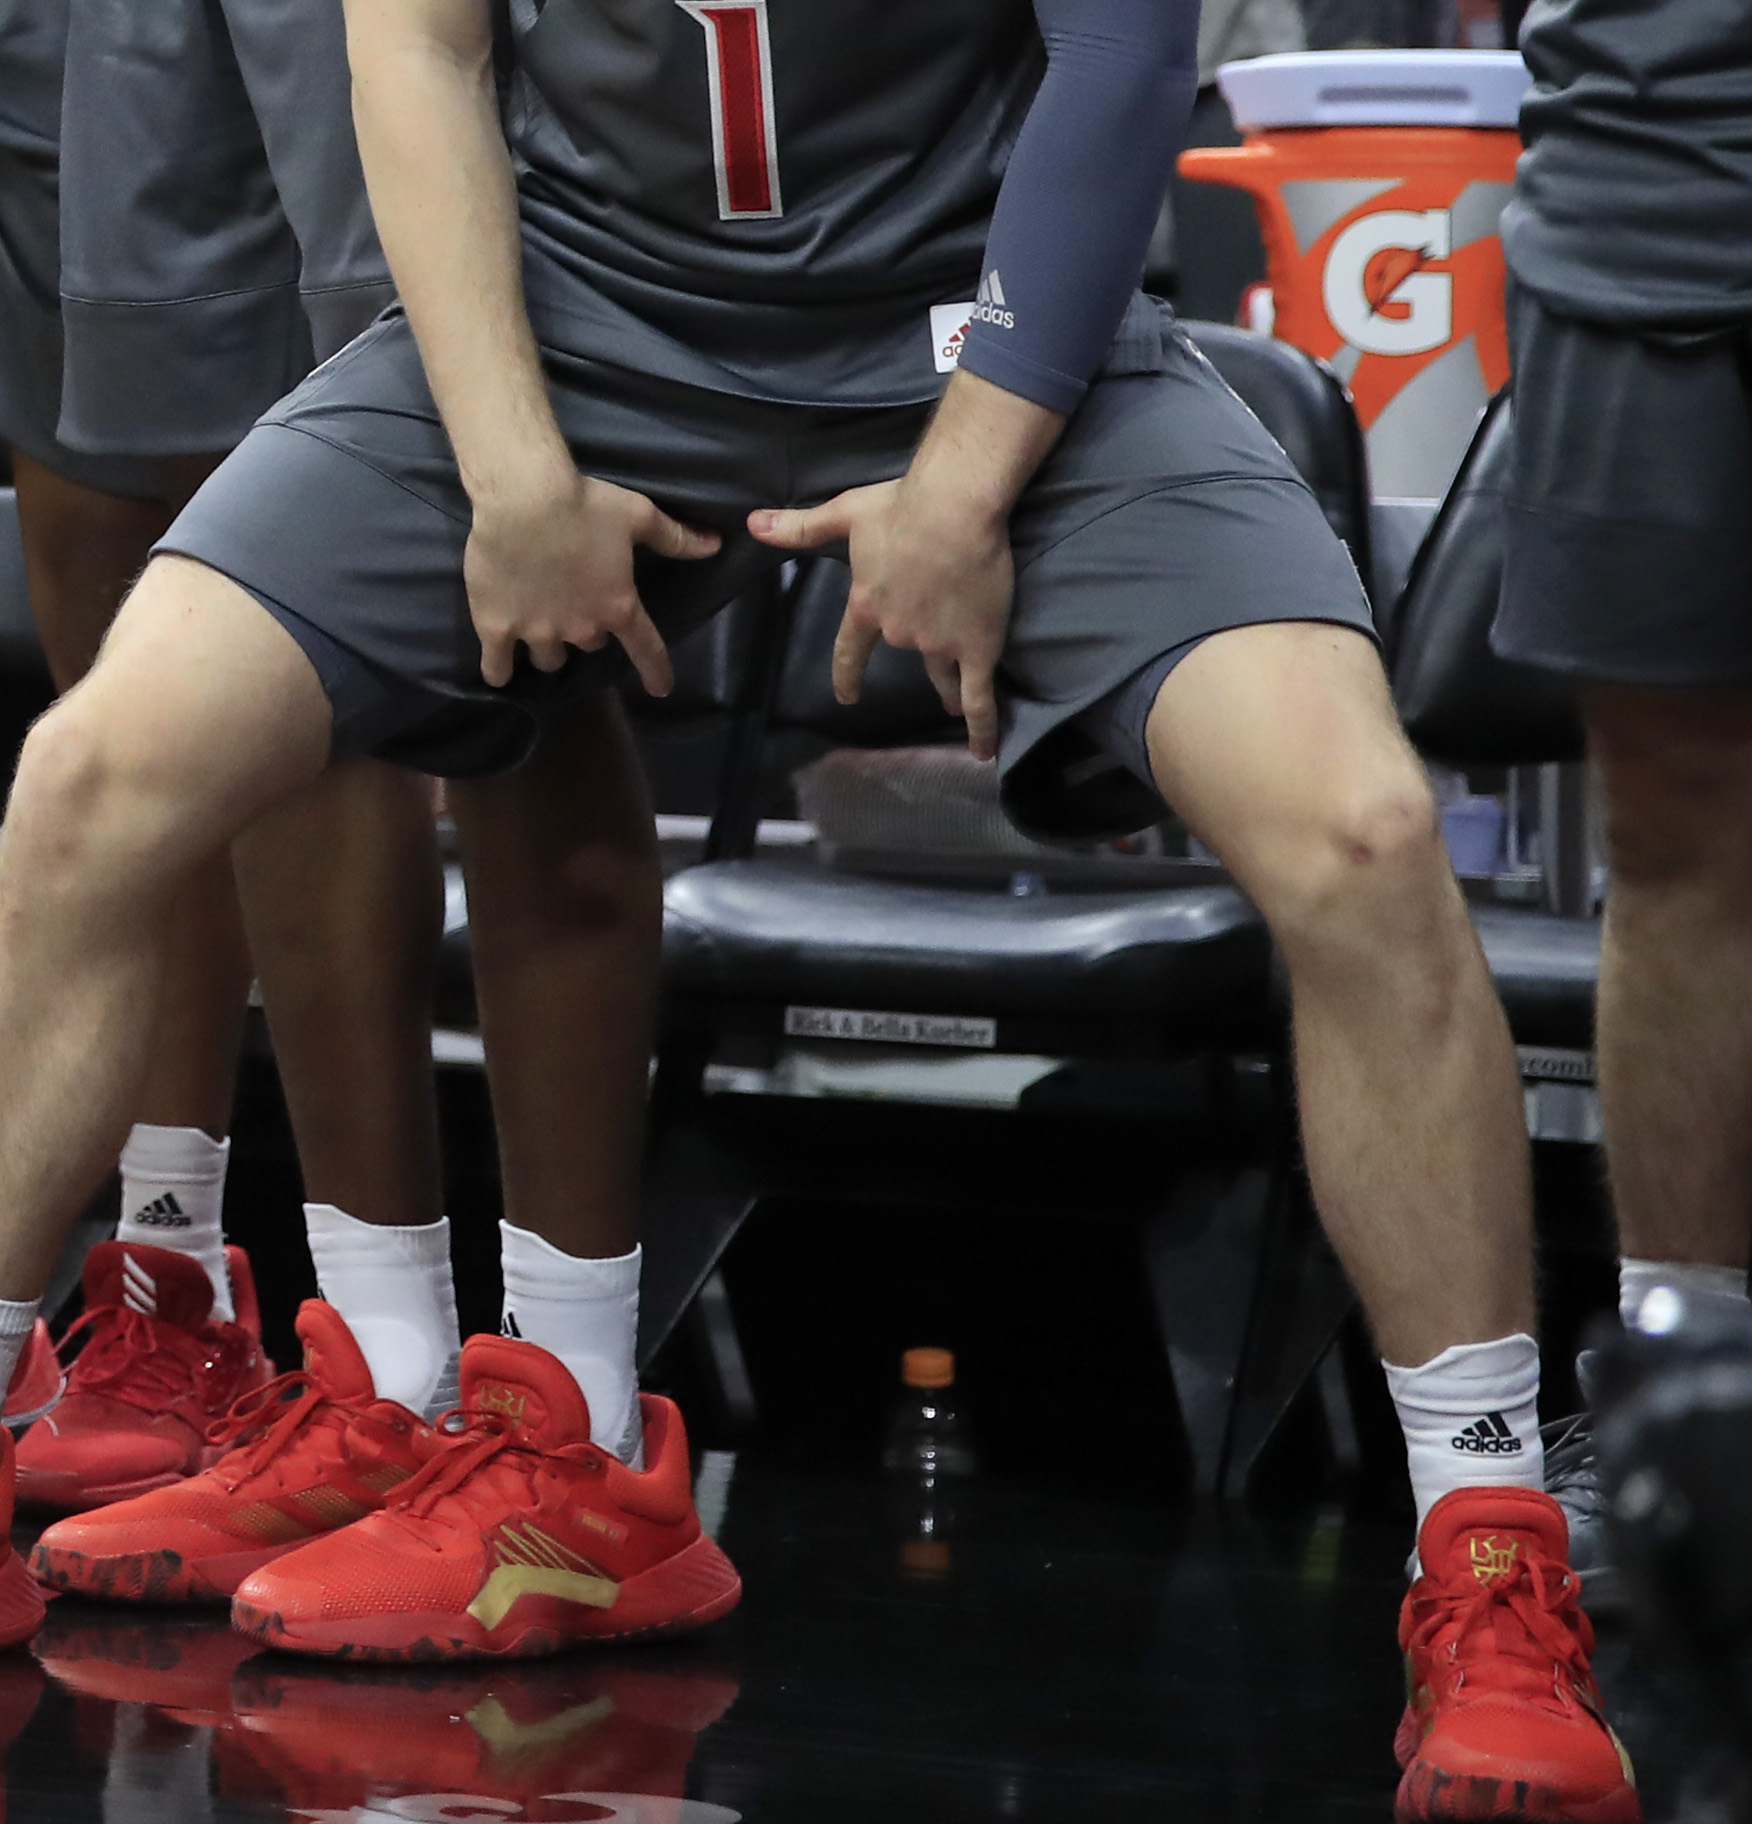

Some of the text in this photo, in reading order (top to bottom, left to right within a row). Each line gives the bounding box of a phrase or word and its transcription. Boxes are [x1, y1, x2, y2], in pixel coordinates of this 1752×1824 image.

[1323, 207, 1454, 357] G
[134, 1210, 193, 1227] adidas
[1451, 1434, 1522, 1455] adidas
